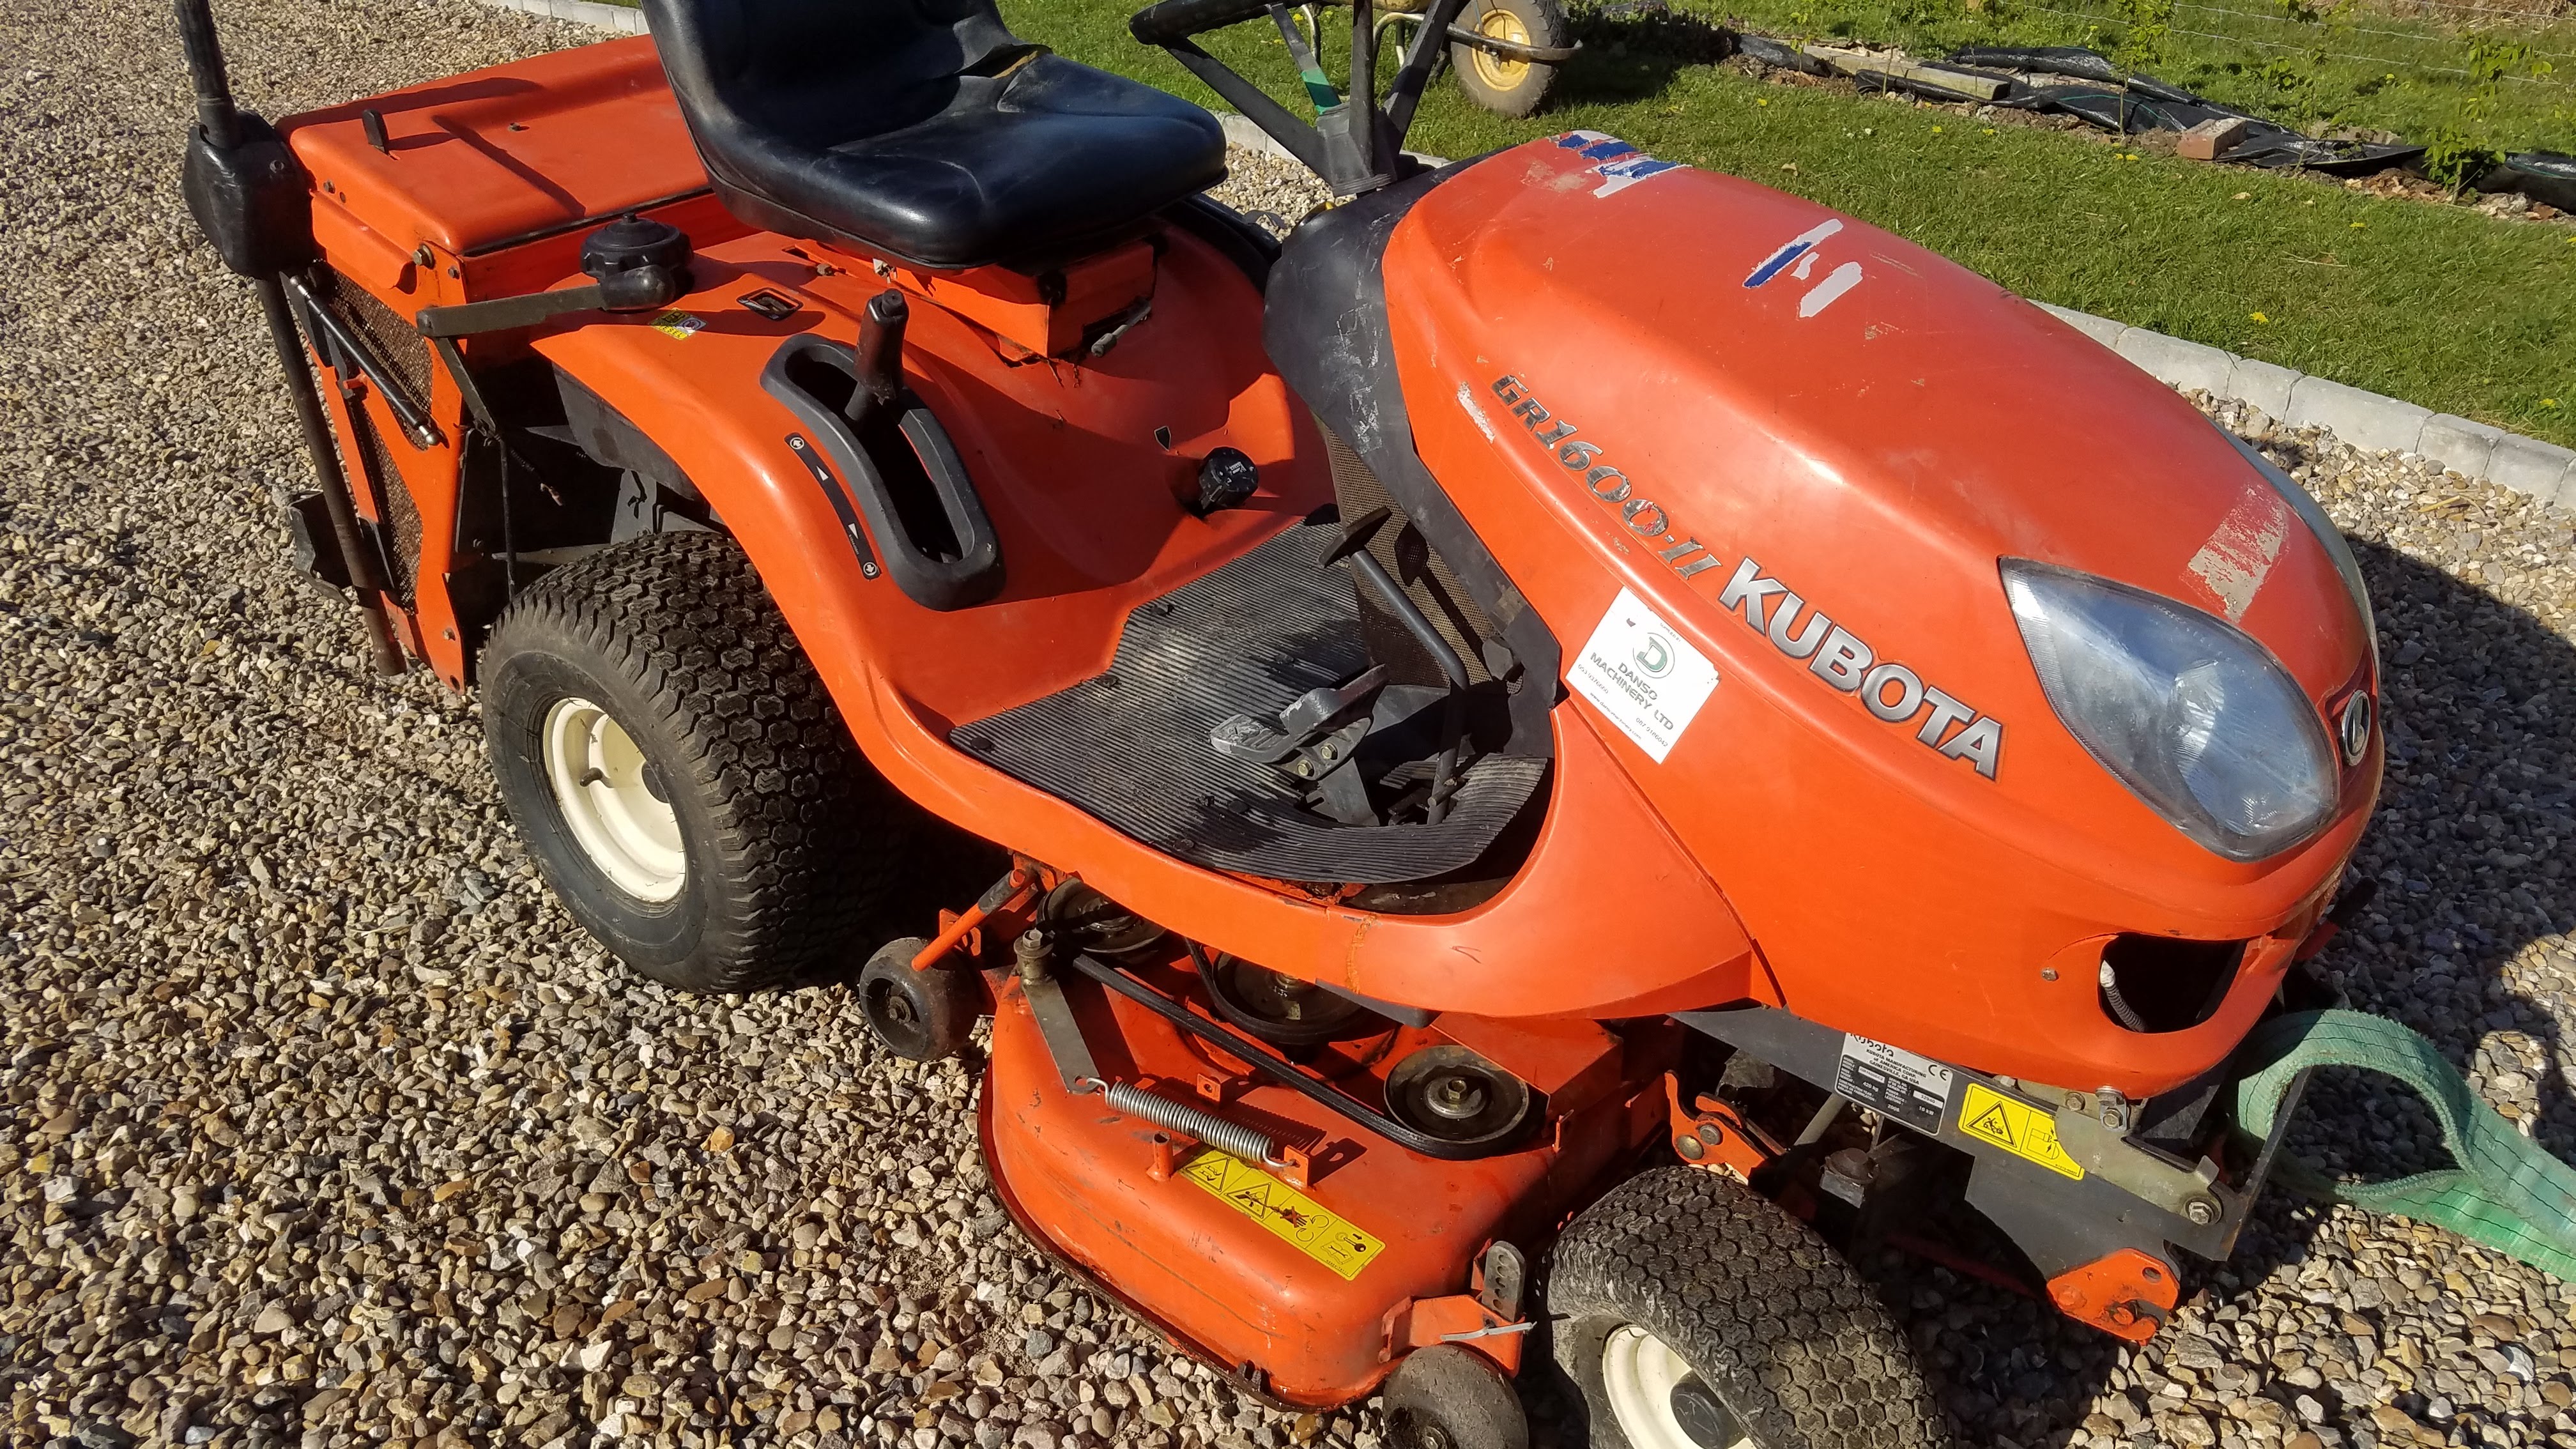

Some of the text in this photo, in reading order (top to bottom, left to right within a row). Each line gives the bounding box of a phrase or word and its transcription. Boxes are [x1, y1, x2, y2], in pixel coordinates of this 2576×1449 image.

[1618, 663, 1658, 700] DANSO
[1719, 557, 2004, 781] KUBOTA
[1590, 652, 1674, 731] MACHINERY LTD
[1866, 1048, 1885, 1059] KUBOTA
[1885, 1057, 1926, 1078] MANUFACTURING
[1880, 1060, 1901, 1072] AMERICA
